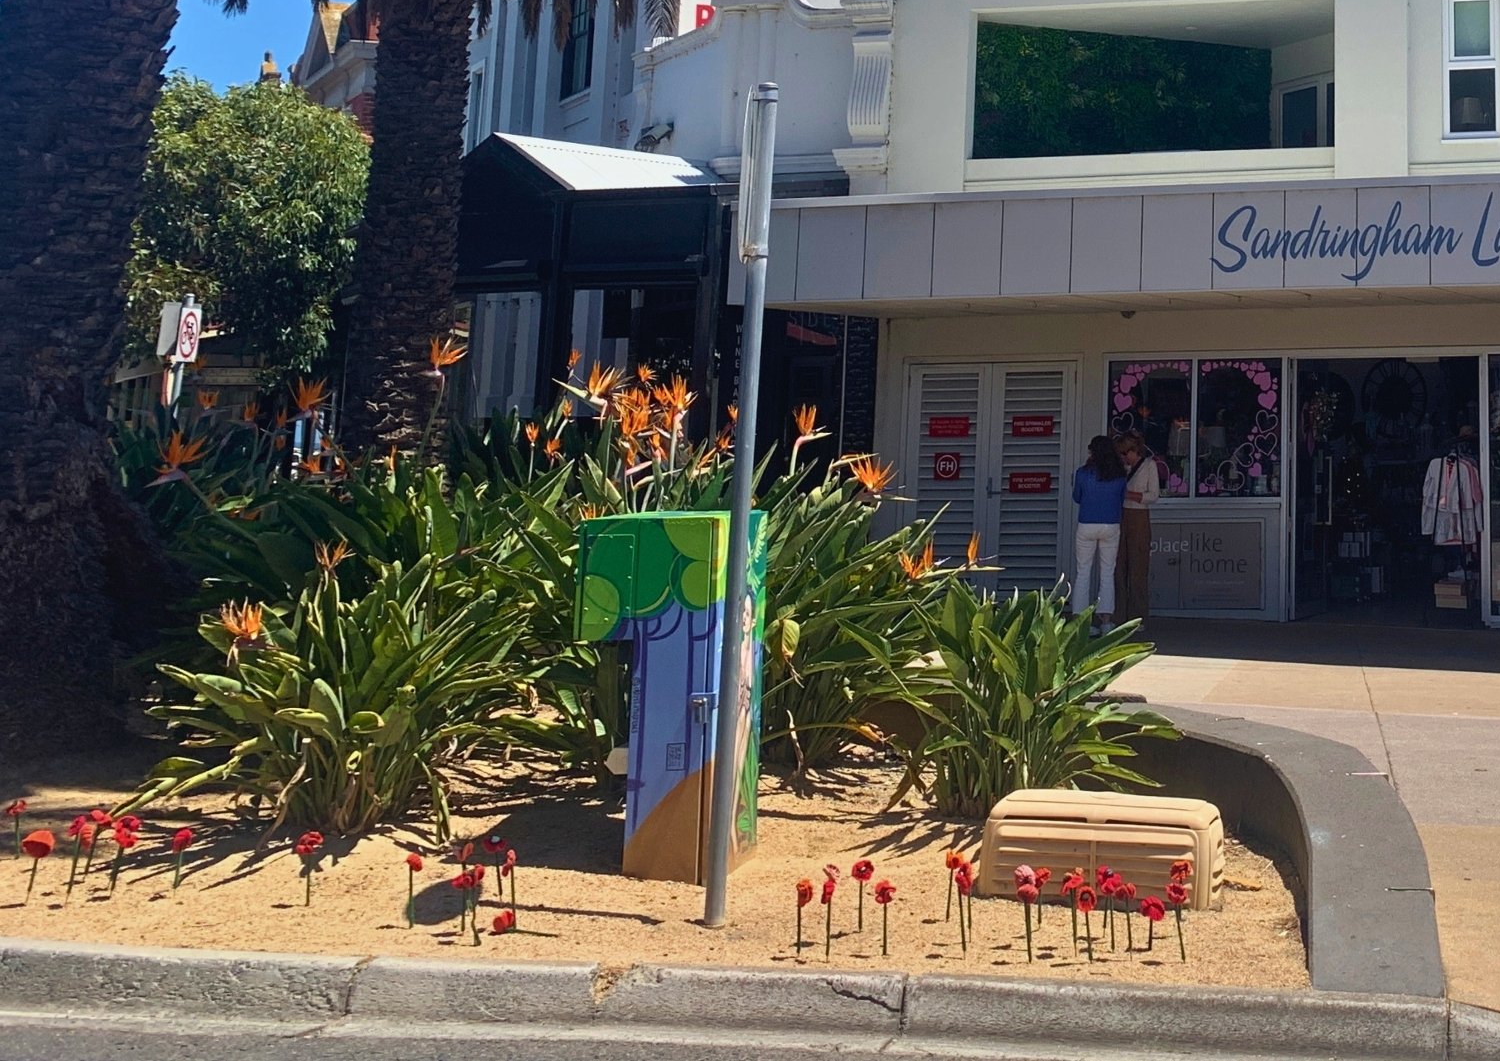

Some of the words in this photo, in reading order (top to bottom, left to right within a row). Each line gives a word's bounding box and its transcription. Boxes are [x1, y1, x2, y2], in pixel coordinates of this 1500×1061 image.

[1210, 200, 1464, 282] Sandringham
[940, 461, 954, 471] FH
[1150, 537, 1189, 557] place
[1190, 531, 1223, 552] like
[1190, 553, 1248, 574] home
